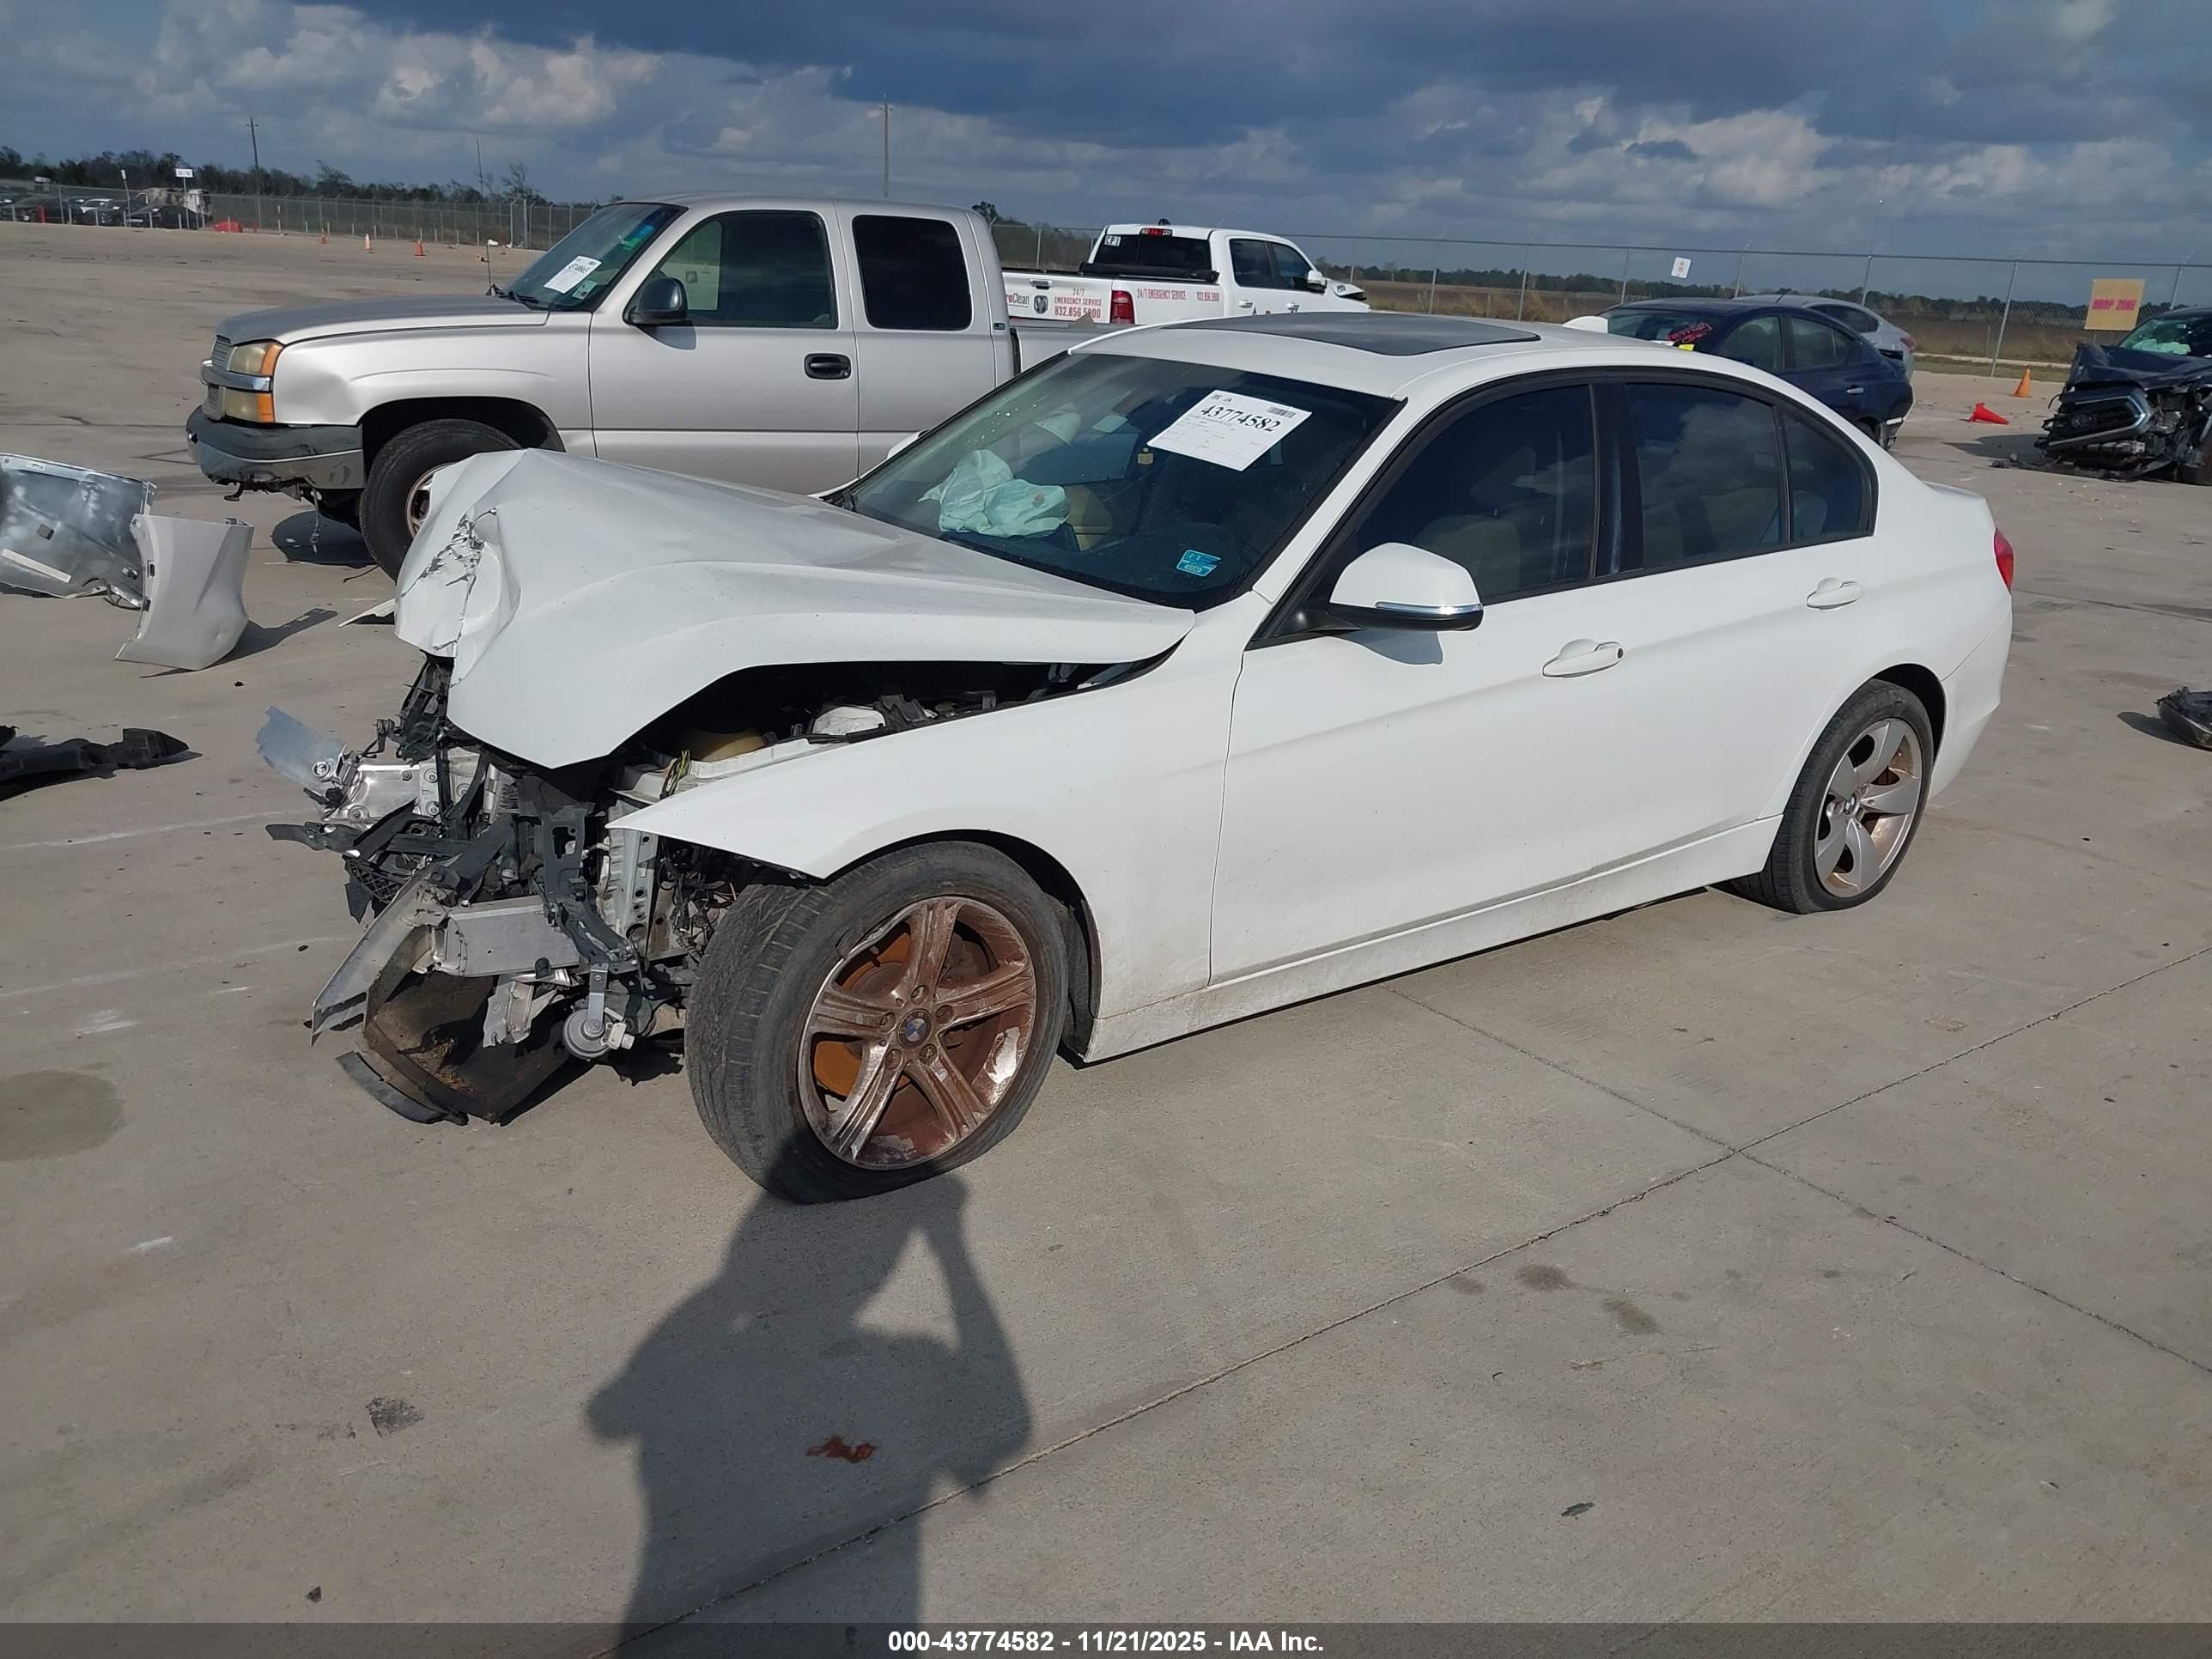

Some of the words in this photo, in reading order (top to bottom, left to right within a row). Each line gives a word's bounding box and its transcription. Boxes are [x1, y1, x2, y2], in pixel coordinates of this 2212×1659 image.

[1054, 296, 1081, 305] EMERGENCY
[1082, 298, 1102, 307] SERVICE
[1054, 306, 1101, 319] 832.8565800
[1200, 404, 1282, 432] 43774582
